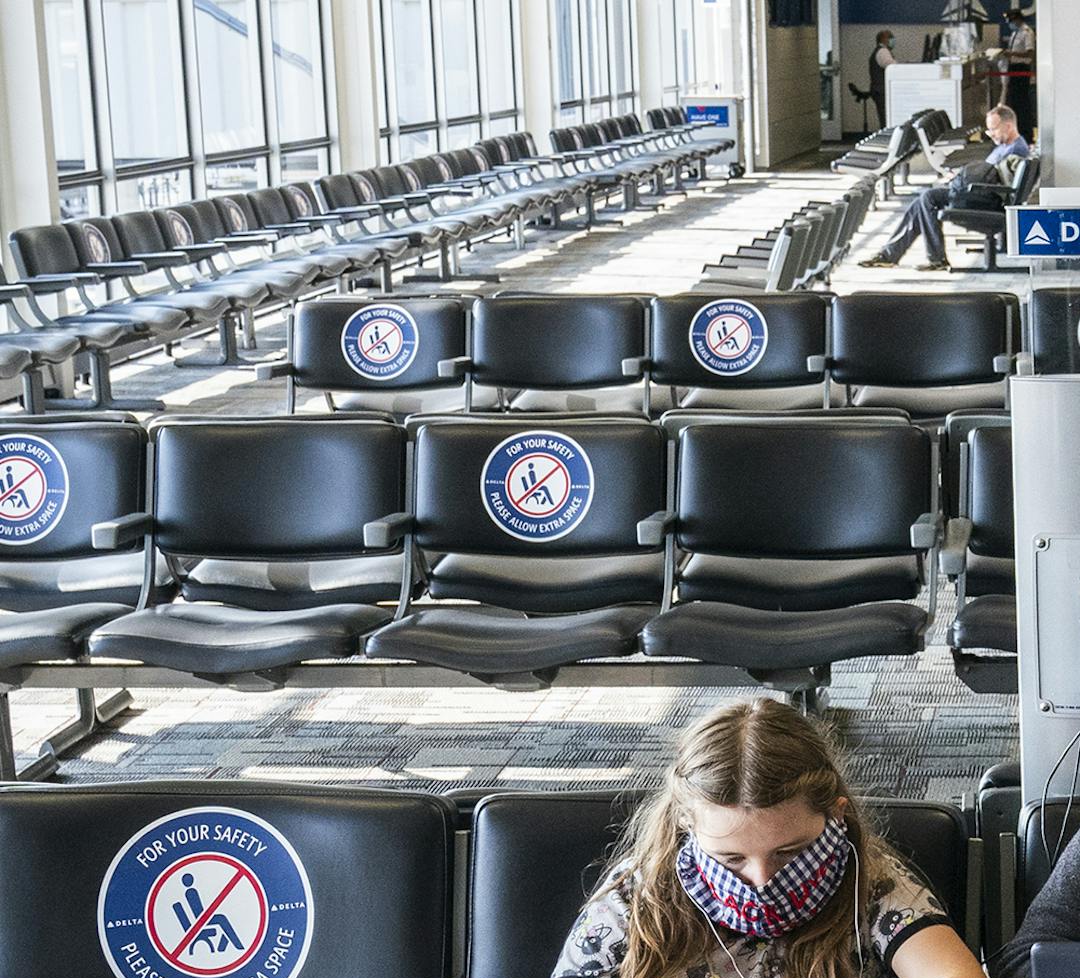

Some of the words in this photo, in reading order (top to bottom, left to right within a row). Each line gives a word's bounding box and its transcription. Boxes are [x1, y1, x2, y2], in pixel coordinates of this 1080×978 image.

[3, 442, 26, 452] YOUR
[26, 444, 52, 465] SAFETY
[506, 443, 523, 457] FOR
[523, 439, 546, 449] YOUR
[547, 440, 575, 460] SAFETY
[15, 523, 41, 536] EXTRA
[39, 500, 57, 525] SPACE
[490, 491, 512, 521] PLEASE
[508, 516, 538, 533] ALLOW
[540, 517, 566, 534] EXTRA
[563, 496, 583, 521] SPACE
[136, 839, 167, 868] FOR
[166, 825, 210, 848] YOUR
[213, 824, 268, 857] SAFETY
[279, 901, 306, 911] DELTA
[115, 918, 143, 928] DELTA
[264, 927, 295, 975] SPACE
